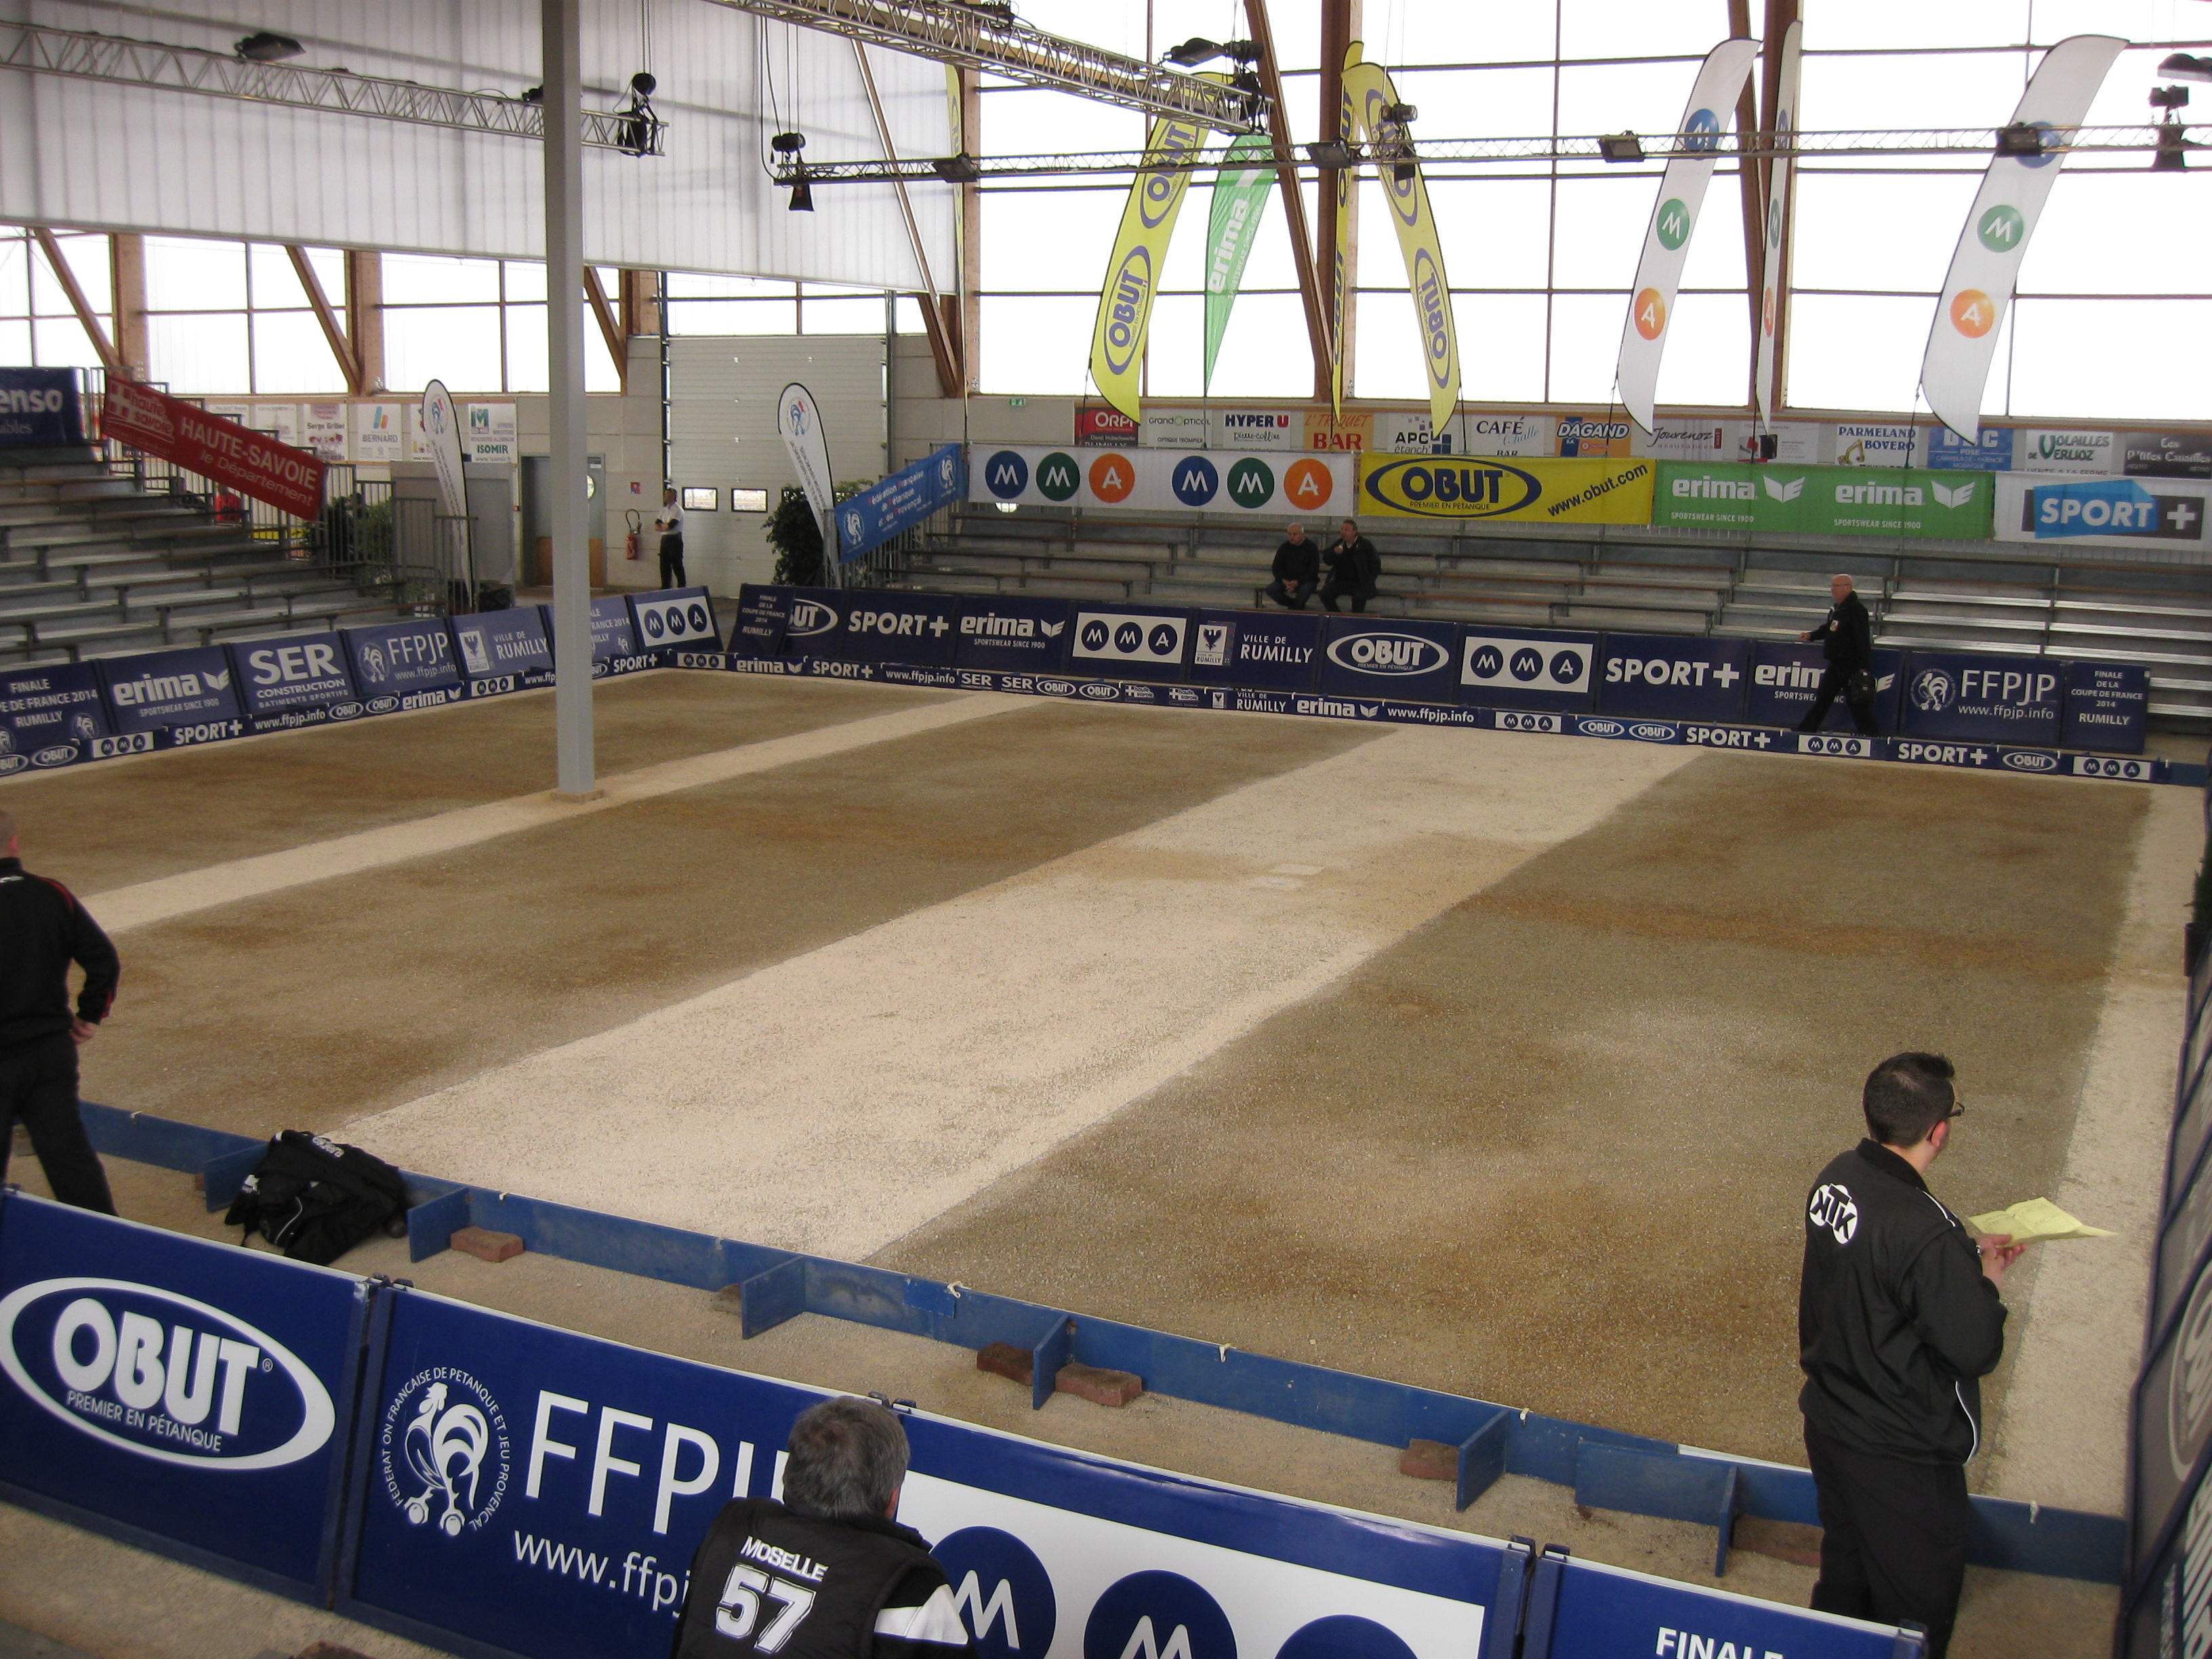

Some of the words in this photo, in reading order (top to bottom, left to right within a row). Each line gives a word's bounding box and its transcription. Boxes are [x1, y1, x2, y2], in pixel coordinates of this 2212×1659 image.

[1208, 198, 1249, 294] erima
[1109, 269, 1143, 347] OBUT
[1225, 415, 1273, 428] HYPER
[1277, 415, 1289, 428] U
[1476, 416, 1524, 435] CAFÉ
[1557, 423, 1629, 438] DAGAND
[363, 434, 398, 443] BERNARD
[1313, 432, 1361, 449] BAR
[1395, 432, 1429, 445] APC
[1839, 426, 1916, 438] PARMELAND
[180, 417, 318, 491] HAUTE-SAVOIE
[477, 445, 509, 453] ISOMIR
[1864, 440, 1916, 451] BOVERO
[201, 449, 213, 464] le
[217, 457, 314, 507] Département
[1401, 467, 1504, 504] OBUT
[1548, 464, 1648, 517] www.obut.com
[1672, 475, 1756, 501] erima
[1835, 480, 1923, 506] erima
[1409, 500, 1440, 510] PREMIER
[1441, 501, 1452, 510] EN
[1671, 512, 1715, 521] SPORTSWEAR
[1715, 513, 1736, 522] SINCE
[1737, 514, 1755, 523] 1900
[1833, 518, 1880, 528] SPORTSWEAR
[1881, 520, 1902, 529] SINCE
[1904, 521, 1921, 529] 1900
[591, 619, 613, 631] RANCE
[960, 612, 1034, 637] erima
[493, 633, 514, 642] VILLE
[516, 630, 527, 639] DE
[1012, 639, 1029, 648] SINCE
[1031, 640, 1046, 649] 1900
[1242, 634, 1269, 644] VILLE
[1274, 635, 1286, 644] DE
[387, 632, 449, 665] FFPJP
[495, 637, 548, 659] RUMILLY
[1240, 644, 1314, 663] RUMILLY
[1351, 638, 1425, 666] OBUT
[249, 643, 342, 685] SER
[395, 662, 457, 680] www.ffpjp.info
[737, 659, 785, 674] erima
[885, 670, 956, 684] www.ffpjp.info
[961, 672, 992, 686] SER
[1001, 676, 1033, 690] SER
[1754, 661, 1826, 689] erim
[2094, 670, 2123, 679] FINALE
[10, 678, 52, 694] FINALE
[113, 673, 201, 707] erima
[256, 678, 346, 699] CONSTRUCTION
[1044, 681, 1069, 694] OBUT
[1086, 684, 1112, 697] OBUT
[1960, 669, 2055, 707] FFPJP
[2096, 680, 2107, 689] DE
[2108, 681, 2119, 689] LA
[10, 699, 26, 712] DE
[27, 693, 71, 709] FRANCE
[71, 689, 99, 702] 2014
[258, 694, 308, 709] BATIMENTS
[309, 689, 349, 701] SPORTIFS
[402, 688, 447, 710] erima
[1774, 691, 1816, 701] SPORTSWE
[2071, 689, 2098, 697] COUPE
[2099, 690, 2111, 698] DE
[2112, 691, 2144, 700] FRANCE
[184, 700, 203, 711] SINCE
[335, 703, 359, 717] OBUT
[372, 697, 393, 711] OBUT
[1236, 699, 1286, 713] RUMILLY
[1296, 697, 1355, 718] erima
[1958, 704, 2055, 720] www.ffpjp.info
[2095, 700, 2116, 708] 2014
[16, 710, 64, 728] RUMILLY
[255, 710, 326, 730] www.ffpjp.info
[1387, 707, 1475, 723] www.ffpjp.info
[2078, 712, 2131, 726] RUMILLY
[1587, 721, 1616, 735] OBUT
[1637, 725, 1667, 739] OBUT
[41, 747, 69, 762] OBUT
[2013, 756, 2046, 768] OBUT
[52, 1296, 260, 1435] OBUT
[433, 1367, 448, 1379] DE
[388, 1369, 432, 1422] FRANCAISE
[449, 1368, 499, 1415] PETANQUE
[66, 1390, 123, 1421] PREMIER
[127, 1409, 144, 1428] EN
[148, 1414, 222, 1452] PÉTANQUE
[494, 1414, 507, 1431] ET
[499, 1435, 510, 1459] JEU
[468, 1463, 510, 1531] PROVENCAL
[740, 1535, 830, 1582] MOSELLE
[715, 1562, 817, 1656] 57
